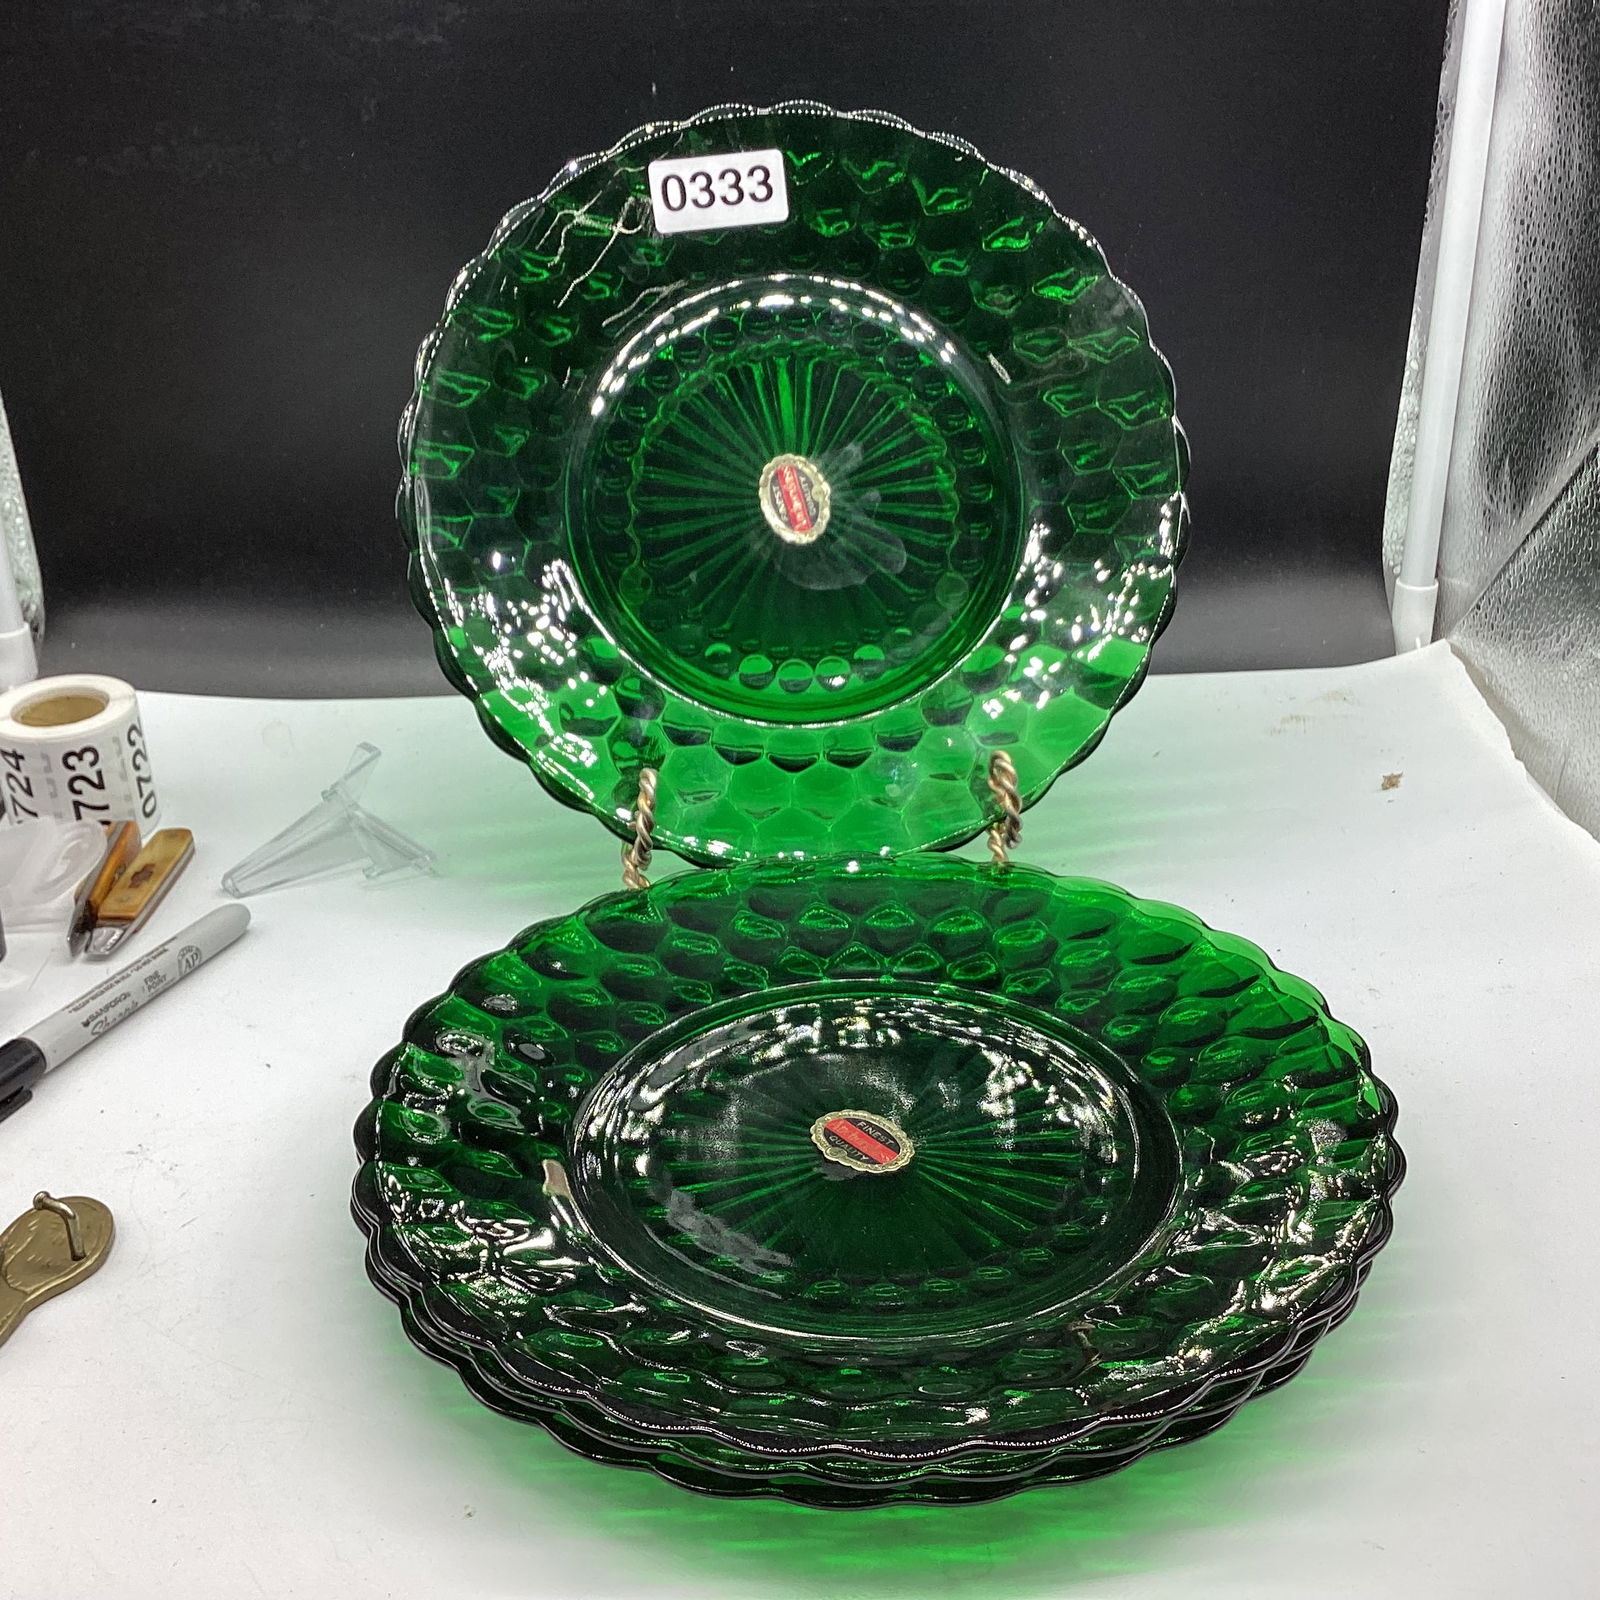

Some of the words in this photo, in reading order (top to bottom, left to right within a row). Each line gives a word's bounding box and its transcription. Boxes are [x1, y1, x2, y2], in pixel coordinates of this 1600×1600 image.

[661, 165, 773, 212] 0333
[0, 749, 38, 824] 724
[62, 746, 112, 826] 723
[127, 718, 157, 819] 0722
[828, 1135, 870, 1161] QUALITY
[856, 1121, 895, 1146] FINEST
